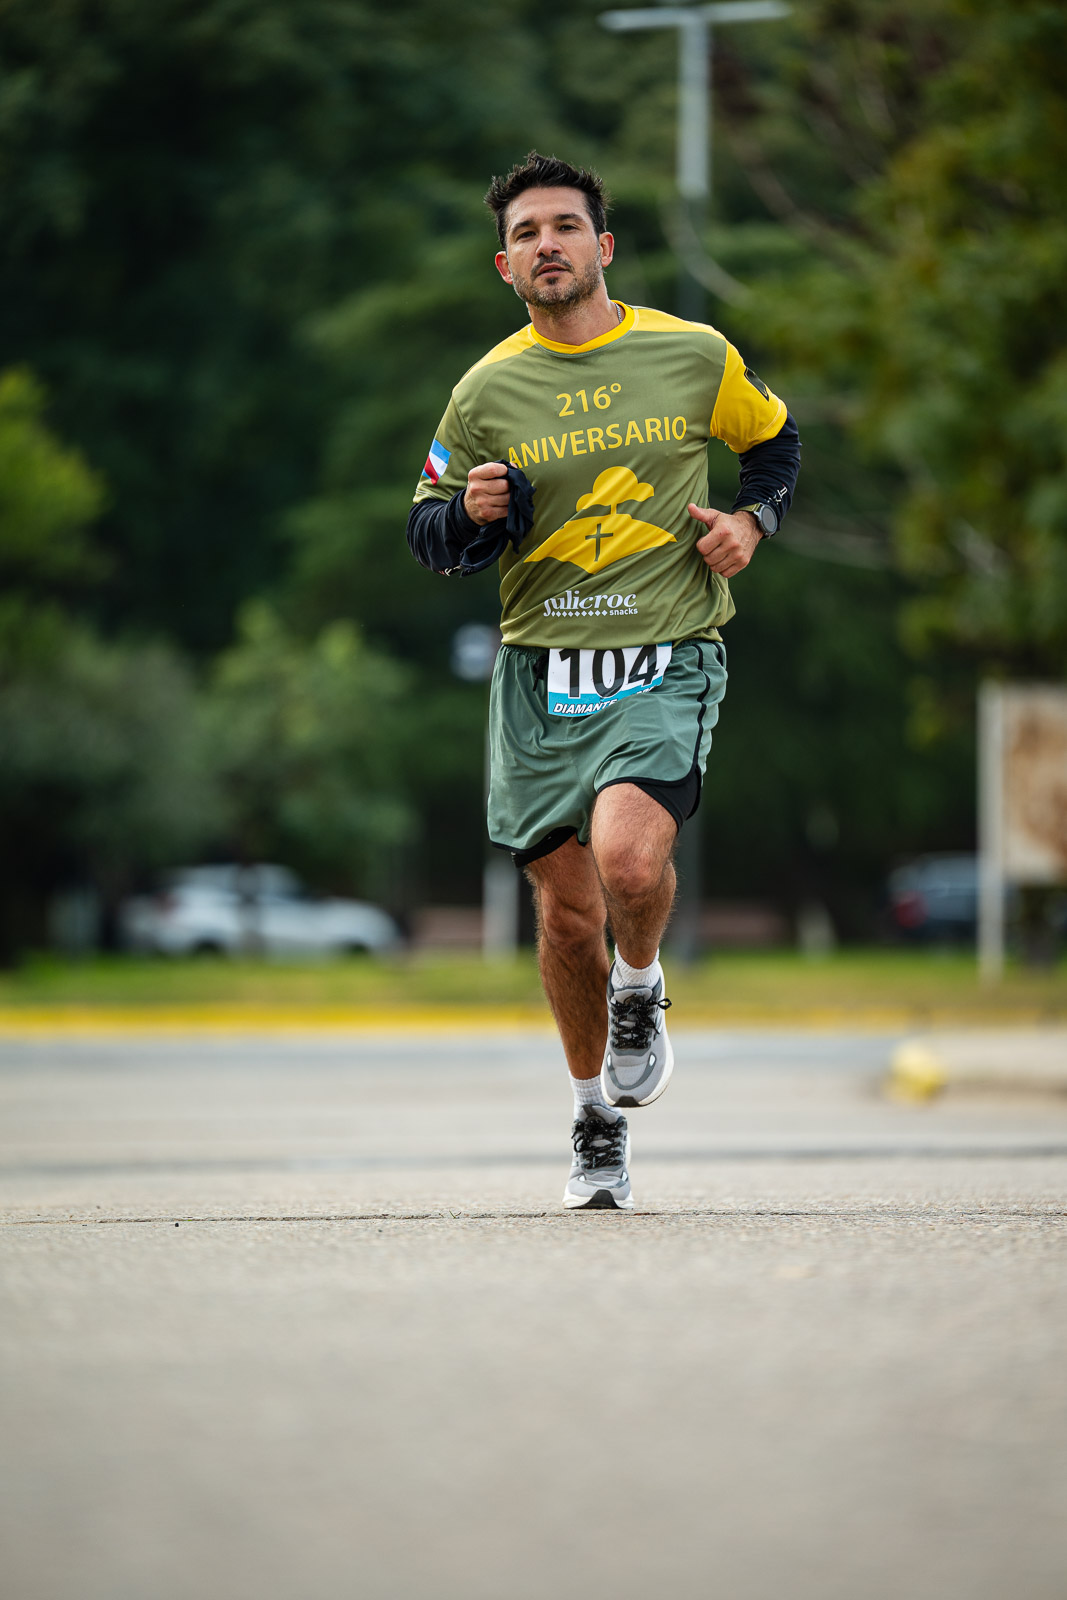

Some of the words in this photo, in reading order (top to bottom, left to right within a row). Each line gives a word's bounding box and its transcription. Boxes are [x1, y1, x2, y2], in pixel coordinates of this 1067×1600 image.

[508, 415, 687, 469] ANIVERSARIO
[609, 607, 639, 616] snacks
[558, 644, 660, 699] 104
